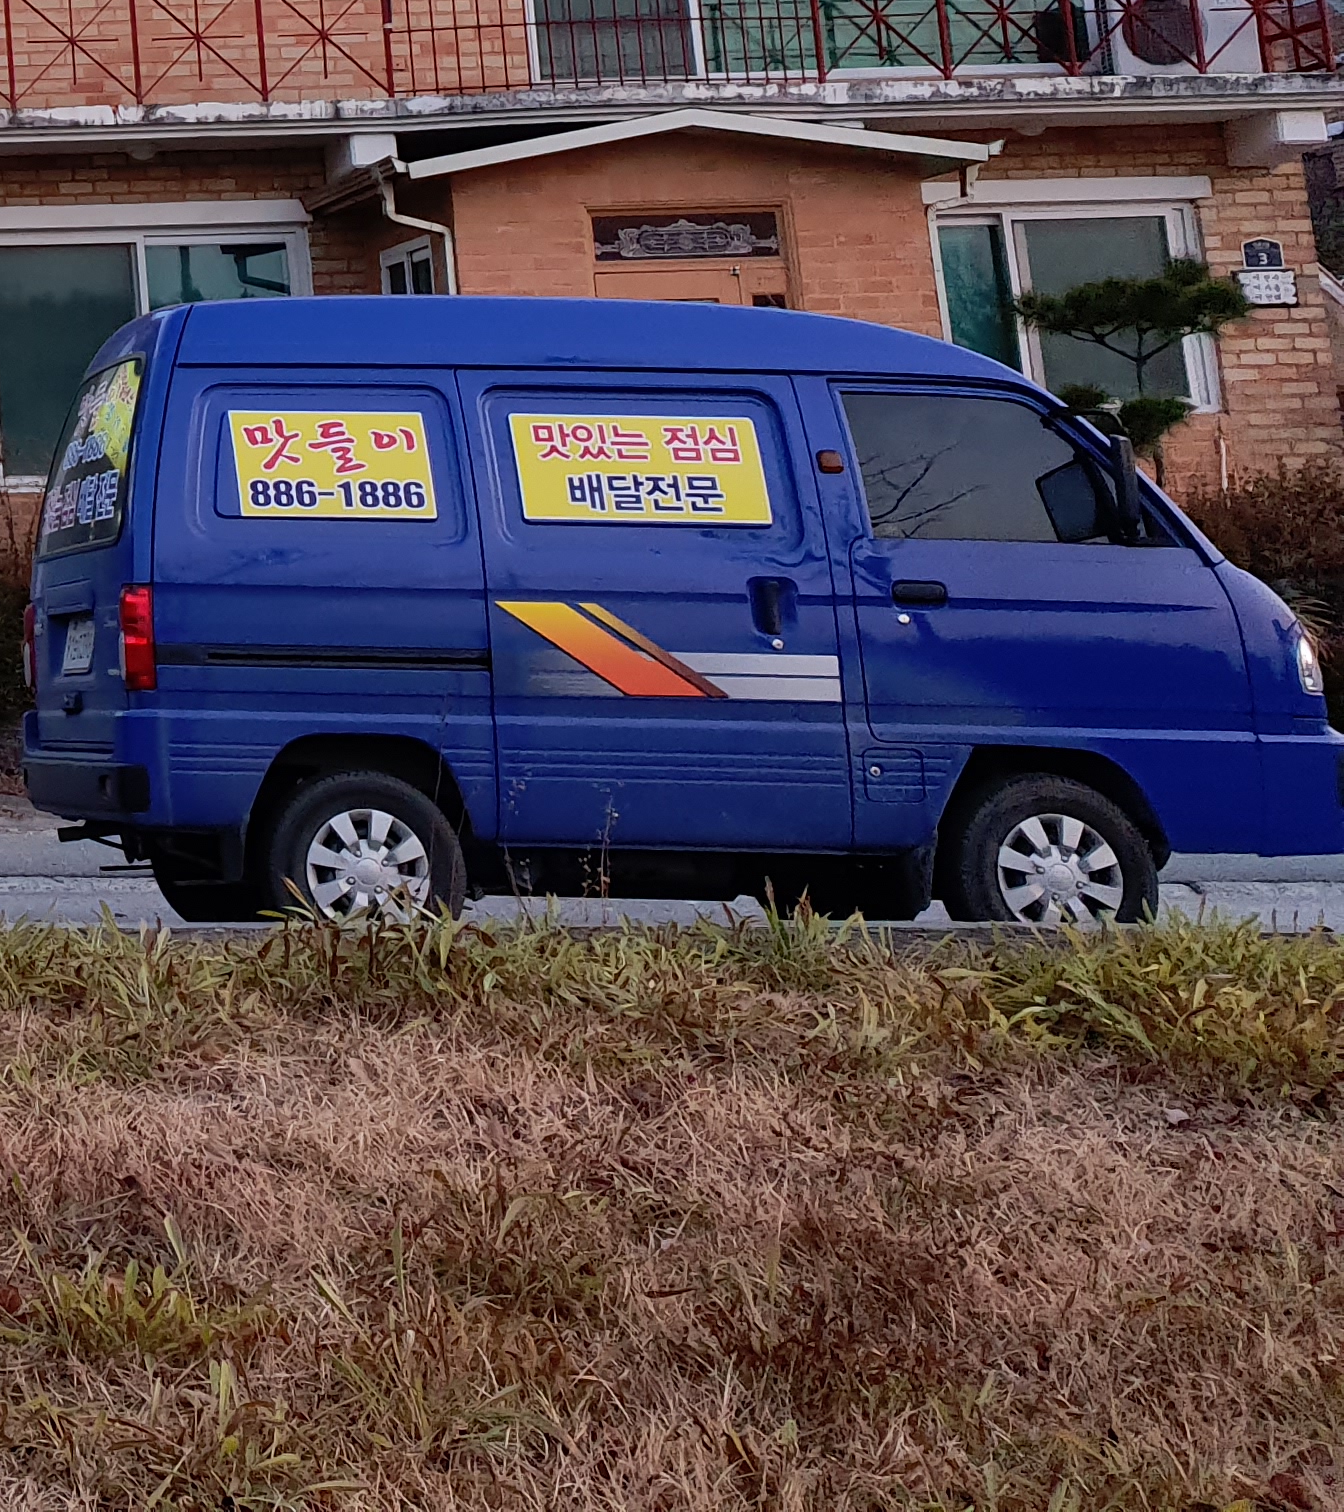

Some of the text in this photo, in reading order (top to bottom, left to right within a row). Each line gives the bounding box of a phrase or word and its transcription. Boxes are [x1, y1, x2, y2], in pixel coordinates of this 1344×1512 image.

[1258, 252, 1268, 265] 3
[242, 417, 416, 475] 맛들이
[531, 422, 743, 465] 맛있는 점심
[249, 478, 426, 509] 886-1886
[566, 472, 726, 513] 배달전문
